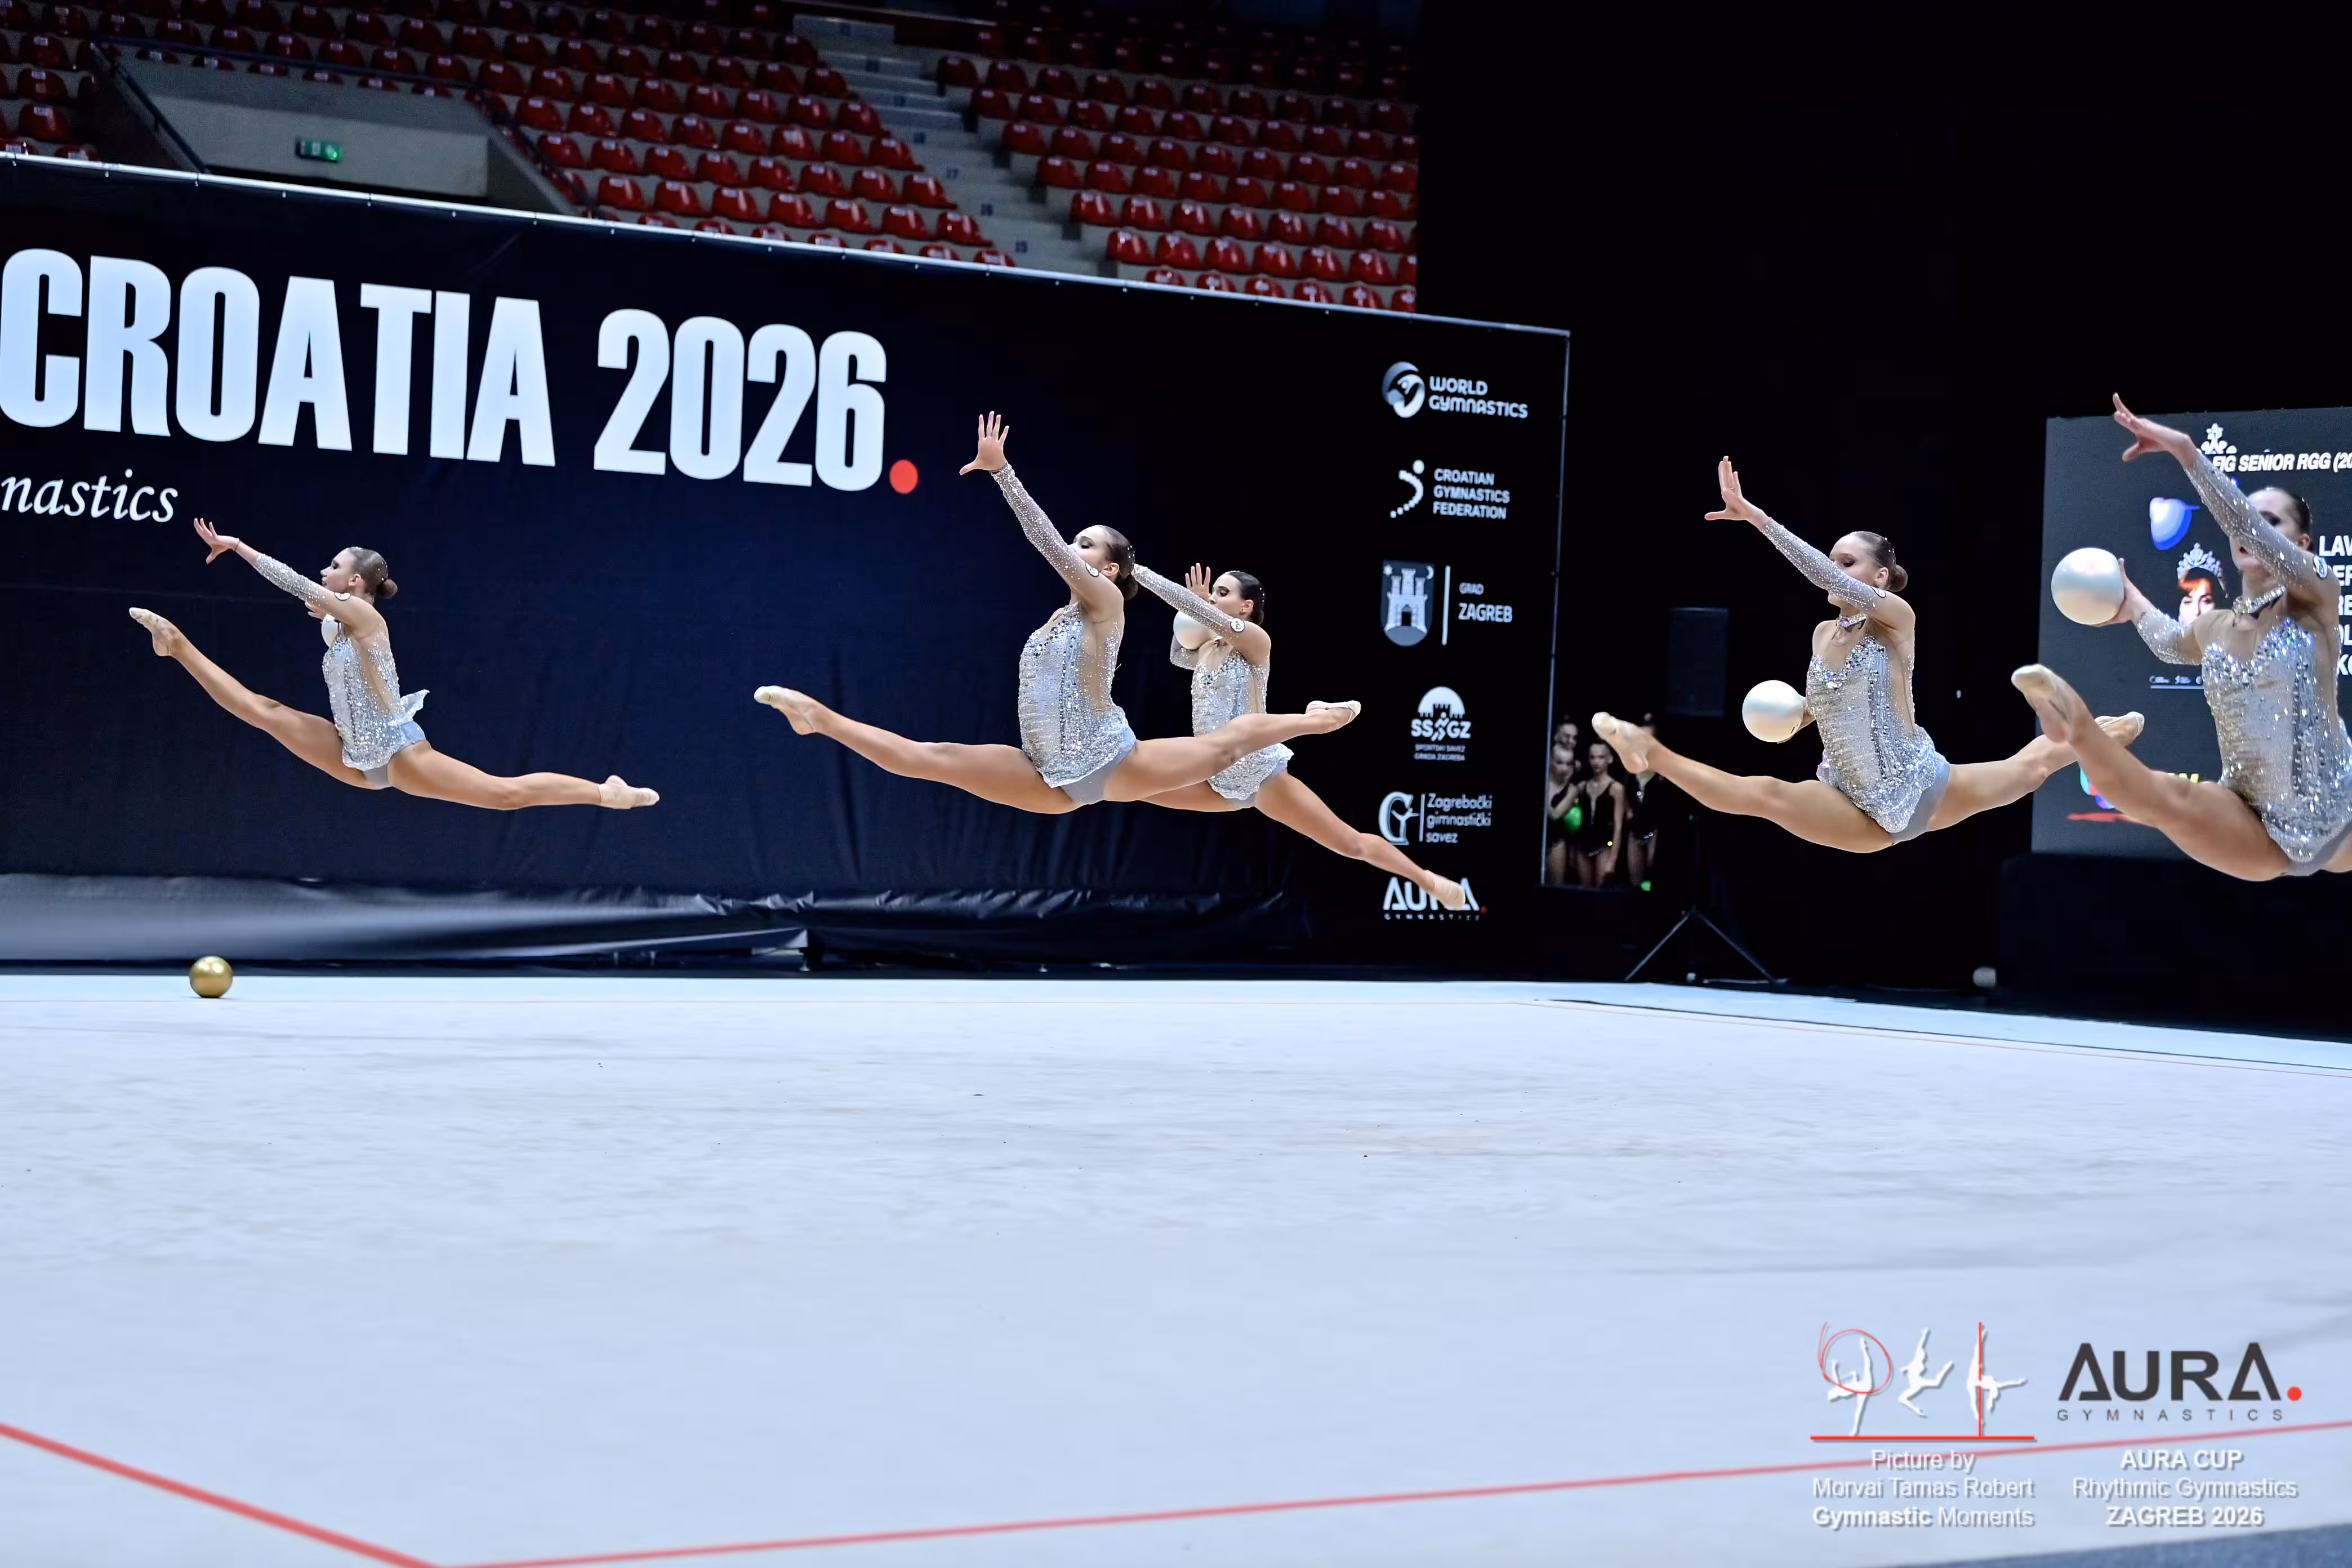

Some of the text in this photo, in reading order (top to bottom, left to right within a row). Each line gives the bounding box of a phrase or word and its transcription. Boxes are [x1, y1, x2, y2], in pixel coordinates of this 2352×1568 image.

[0, 248, 555, 466] CROATIA
[1429, 376, 1488, 395] WORLD
[1428, 395, 1528, 418] GYMNASTICS
[2238, 453, 2295, 471] SENIOR
[2297, 452, 2331, 470] RGG
[1434, 468, 1495, 485] CROATIAN
[1, 469, 178, 523] nastics
[1433, 485, 1510, 504] GYMNASTICS
[1433, 501, 1507, 519] FEDERATION
[1459, 582, 1484, 595] GRAD
[1458, 603, 1513, 623] ZAGREB
[1426, 832, 1458, 843] savez
